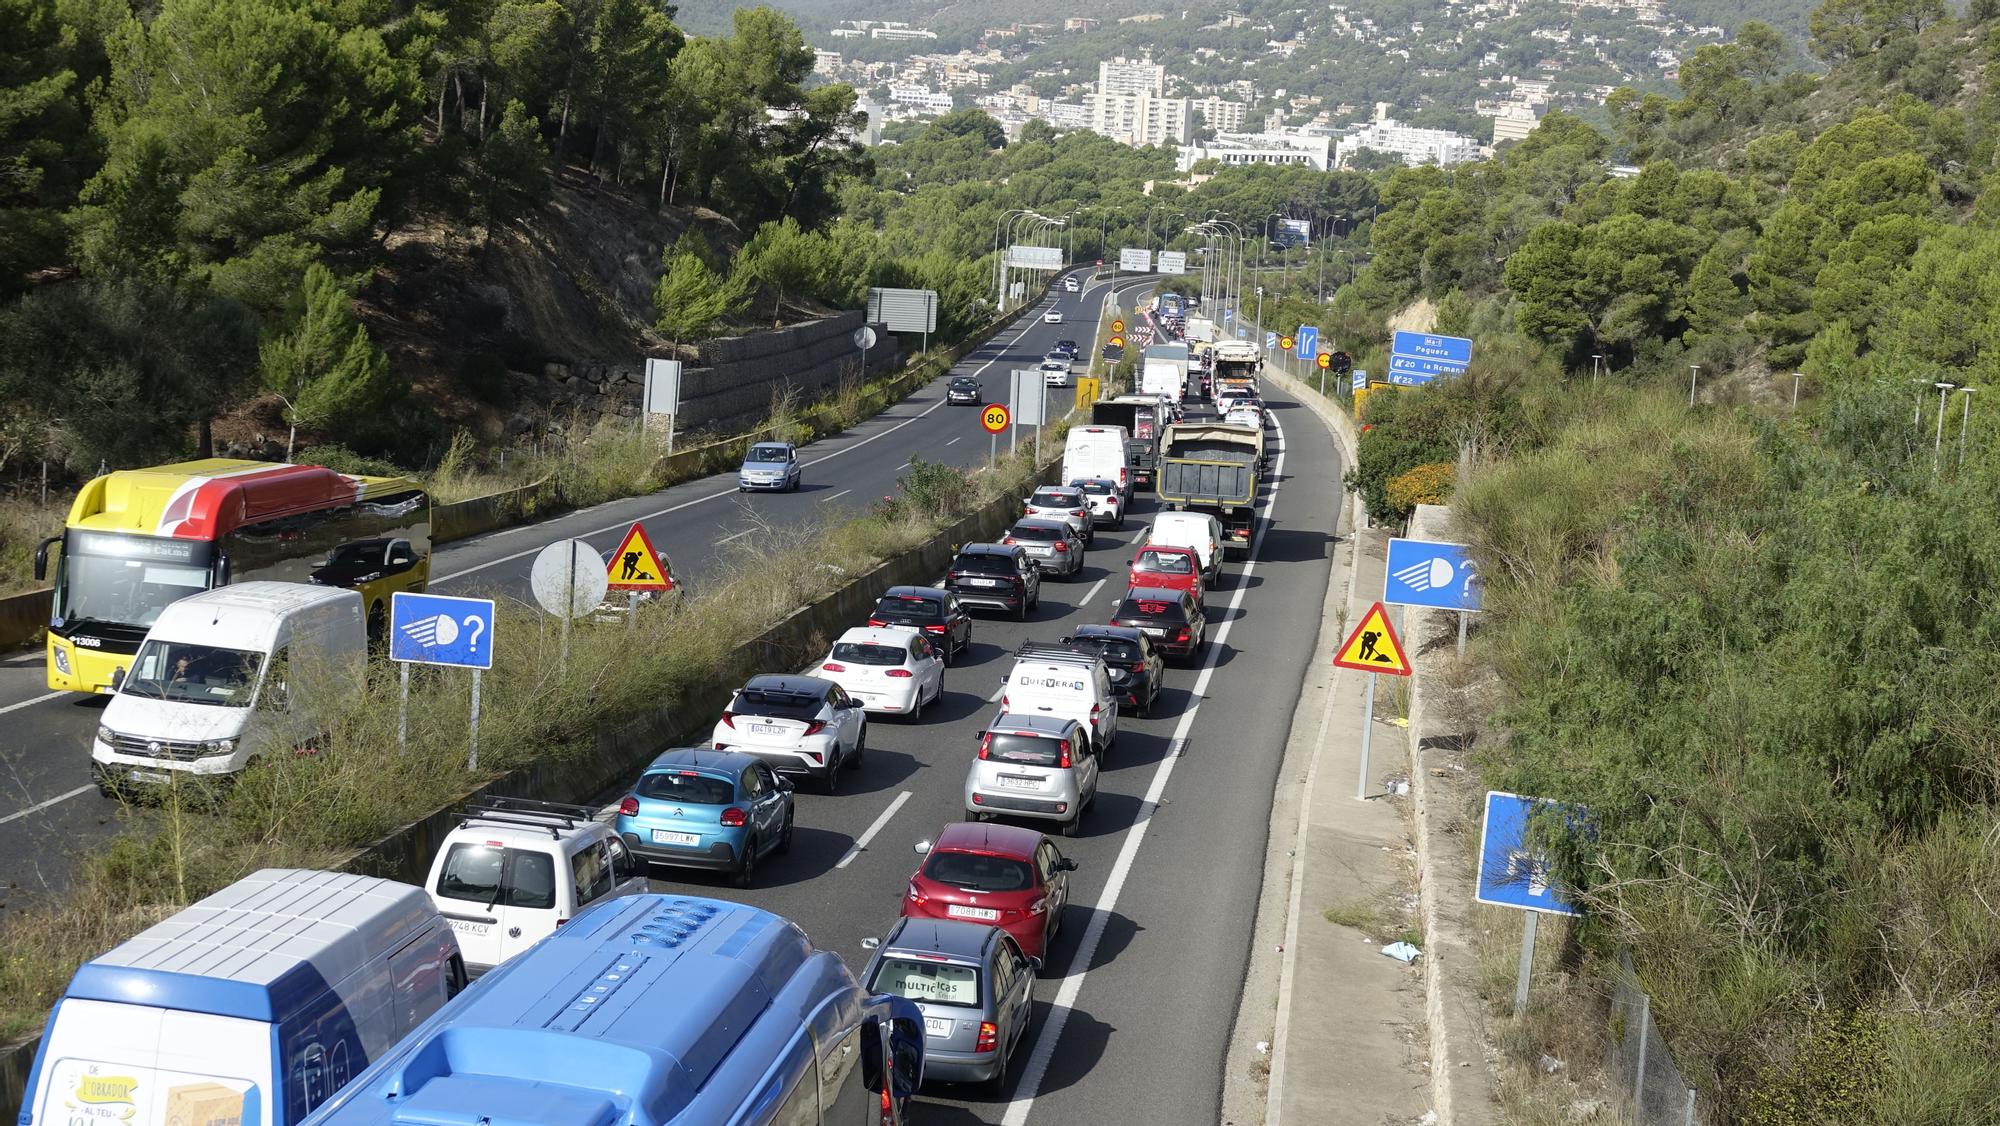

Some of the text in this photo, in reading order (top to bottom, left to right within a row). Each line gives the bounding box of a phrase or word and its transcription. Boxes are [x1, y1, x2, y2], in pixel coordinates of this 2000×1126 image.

[1415, 345, 1449, 356] Peguera
[1404, 360, 1416, 368] 20
[1403, 376, 1413, 384] 22
[987, 413, 1004, 424] 80
[75, 637, 101, 647] 13006
[471, 924, 490, 934] KCV
[926, 1019, 945, 1030] CDL
[83, 1081, 129, 1098] L'OBRADOR
